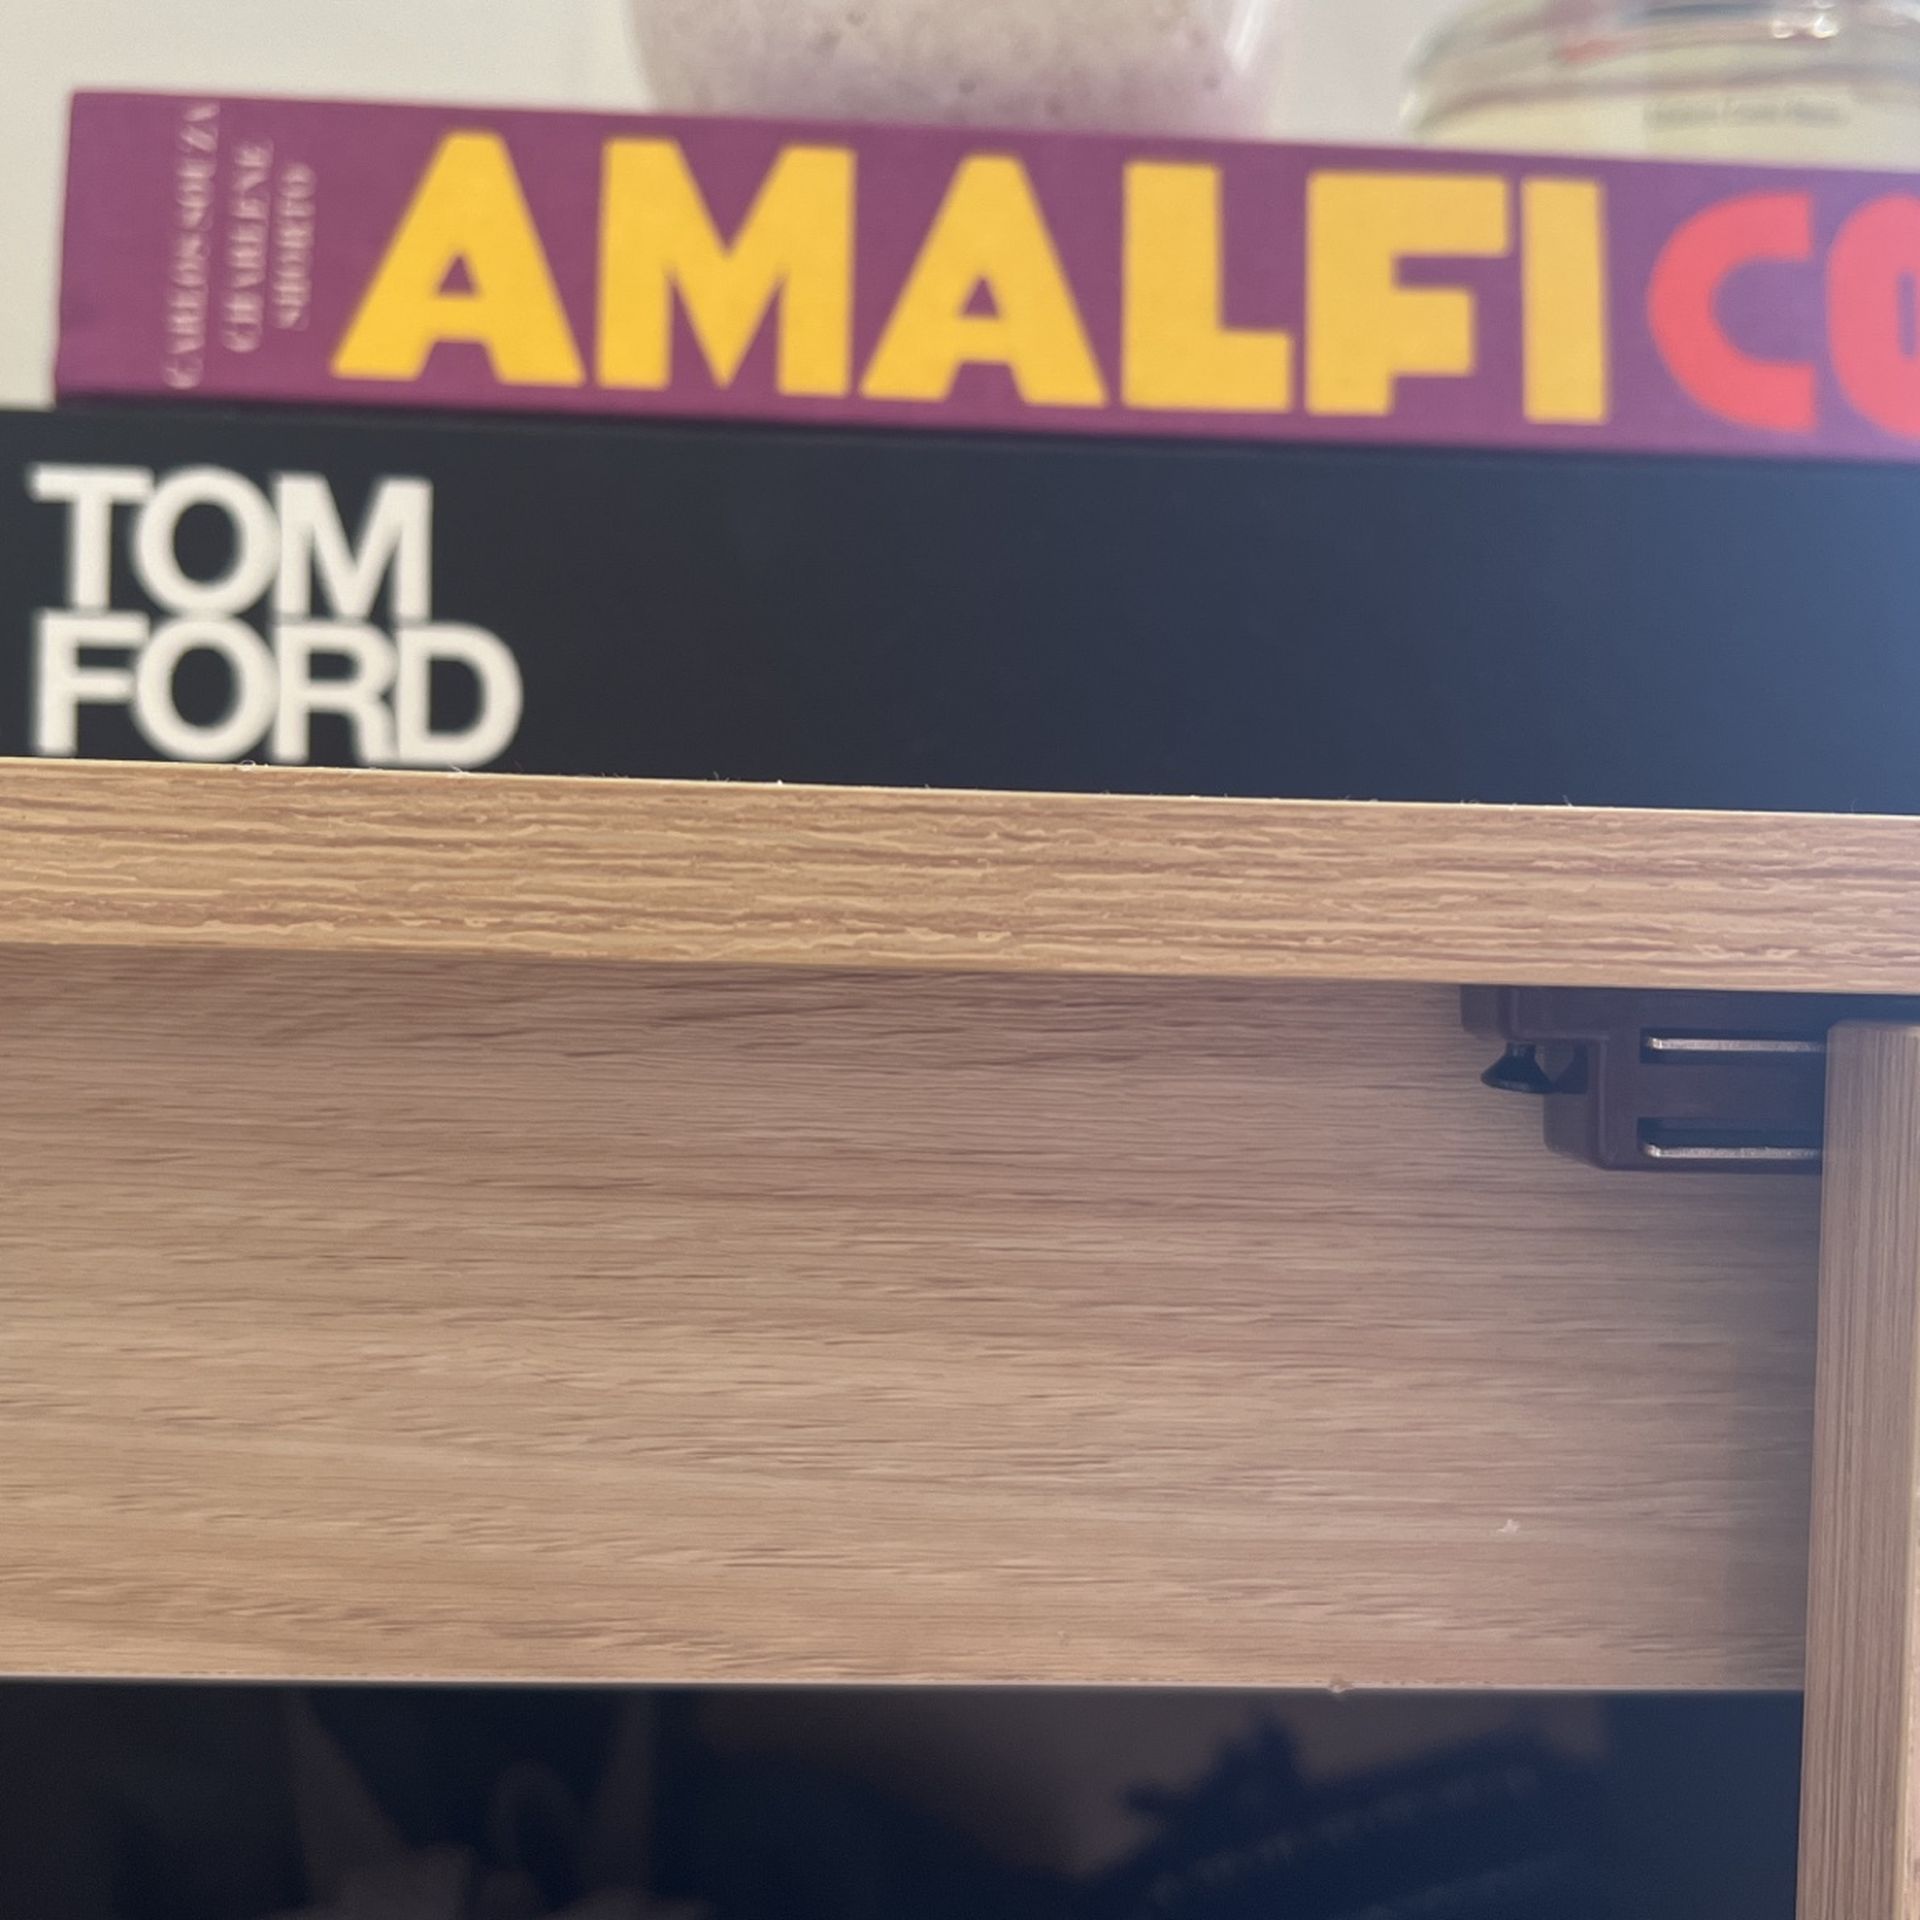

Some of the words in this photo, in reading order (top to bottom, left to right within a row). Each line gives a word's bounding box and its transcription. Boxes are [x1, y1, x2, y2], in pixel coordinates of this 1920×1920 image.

[332, 129, 1607, 424] AMALFI
[1647, 191, 1920, 438] CO
[29, 464, 433, 622] TOM
[34, 608, 522, 767] FORD
